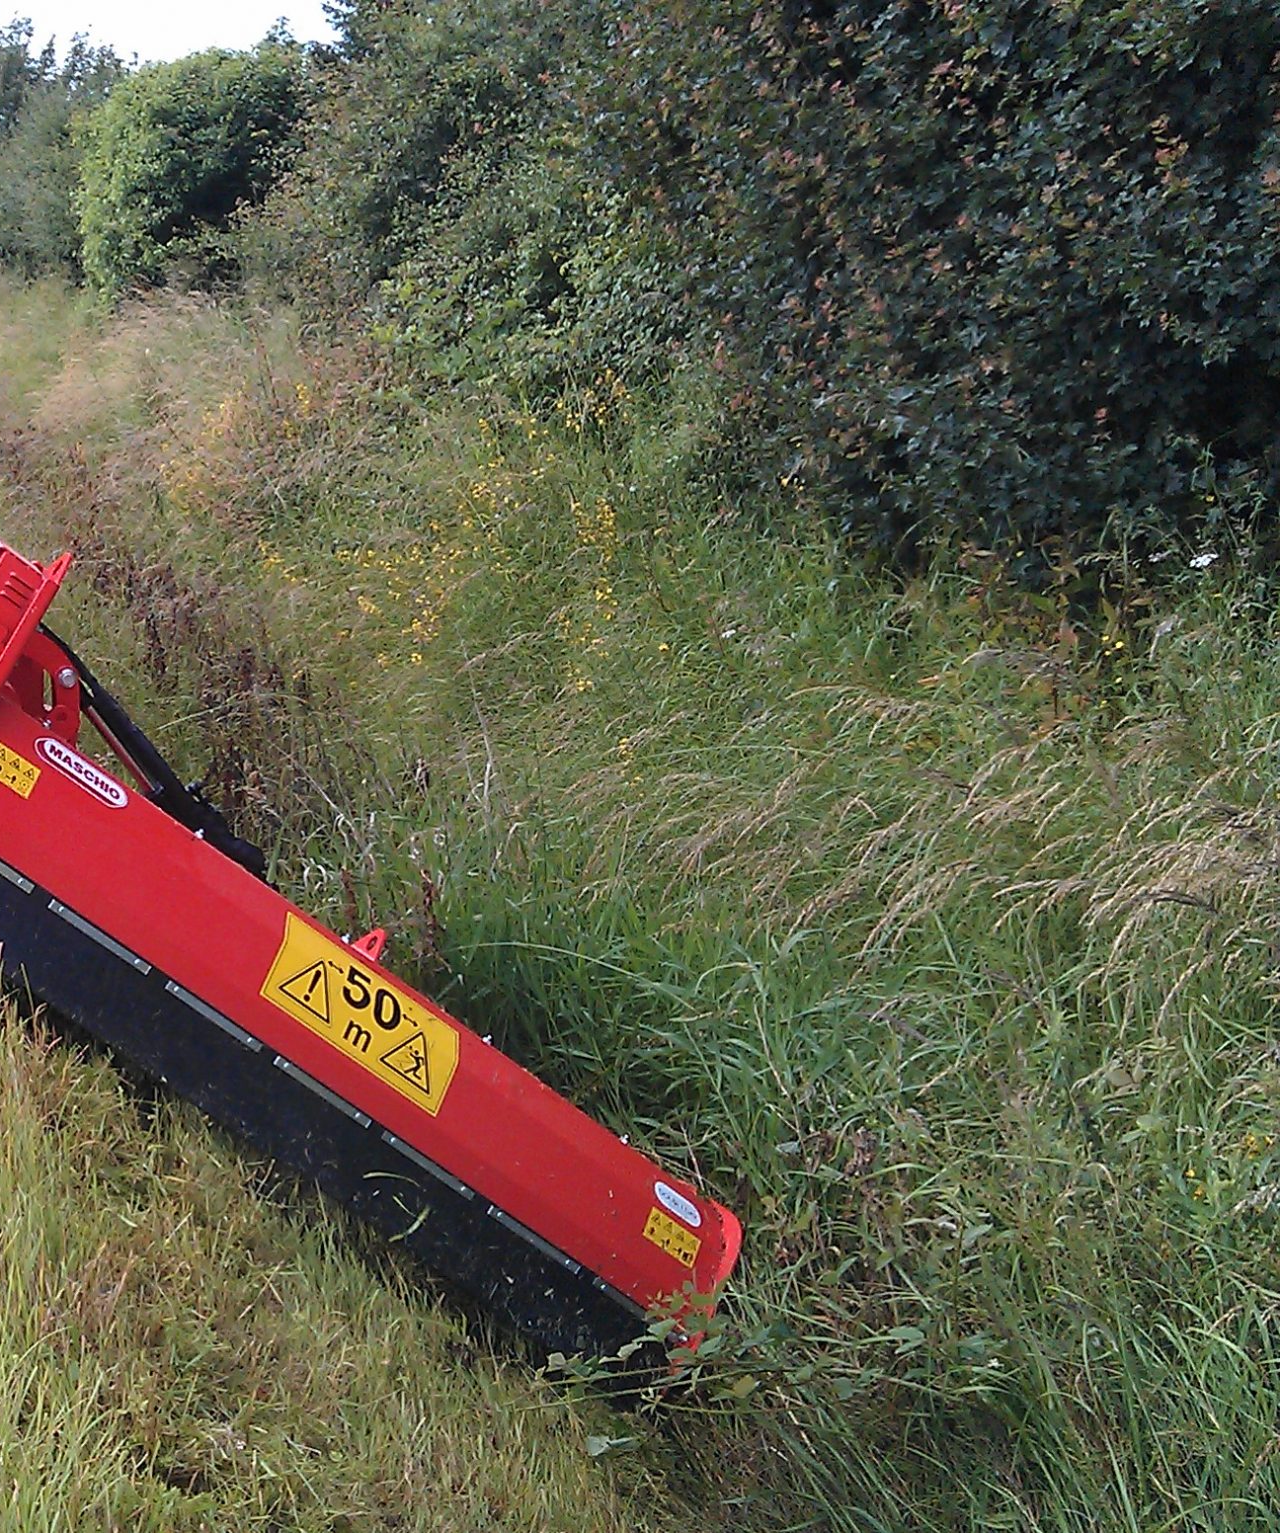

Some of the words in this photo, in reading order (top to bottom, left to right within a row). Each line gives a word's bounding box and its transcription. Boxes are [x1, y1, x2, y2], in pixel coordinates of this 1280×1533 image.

[48, 744, 121, 800] MASCHIO
[342, 965, 401, 1031] 50
[342, 1019, 372, 1053] m
